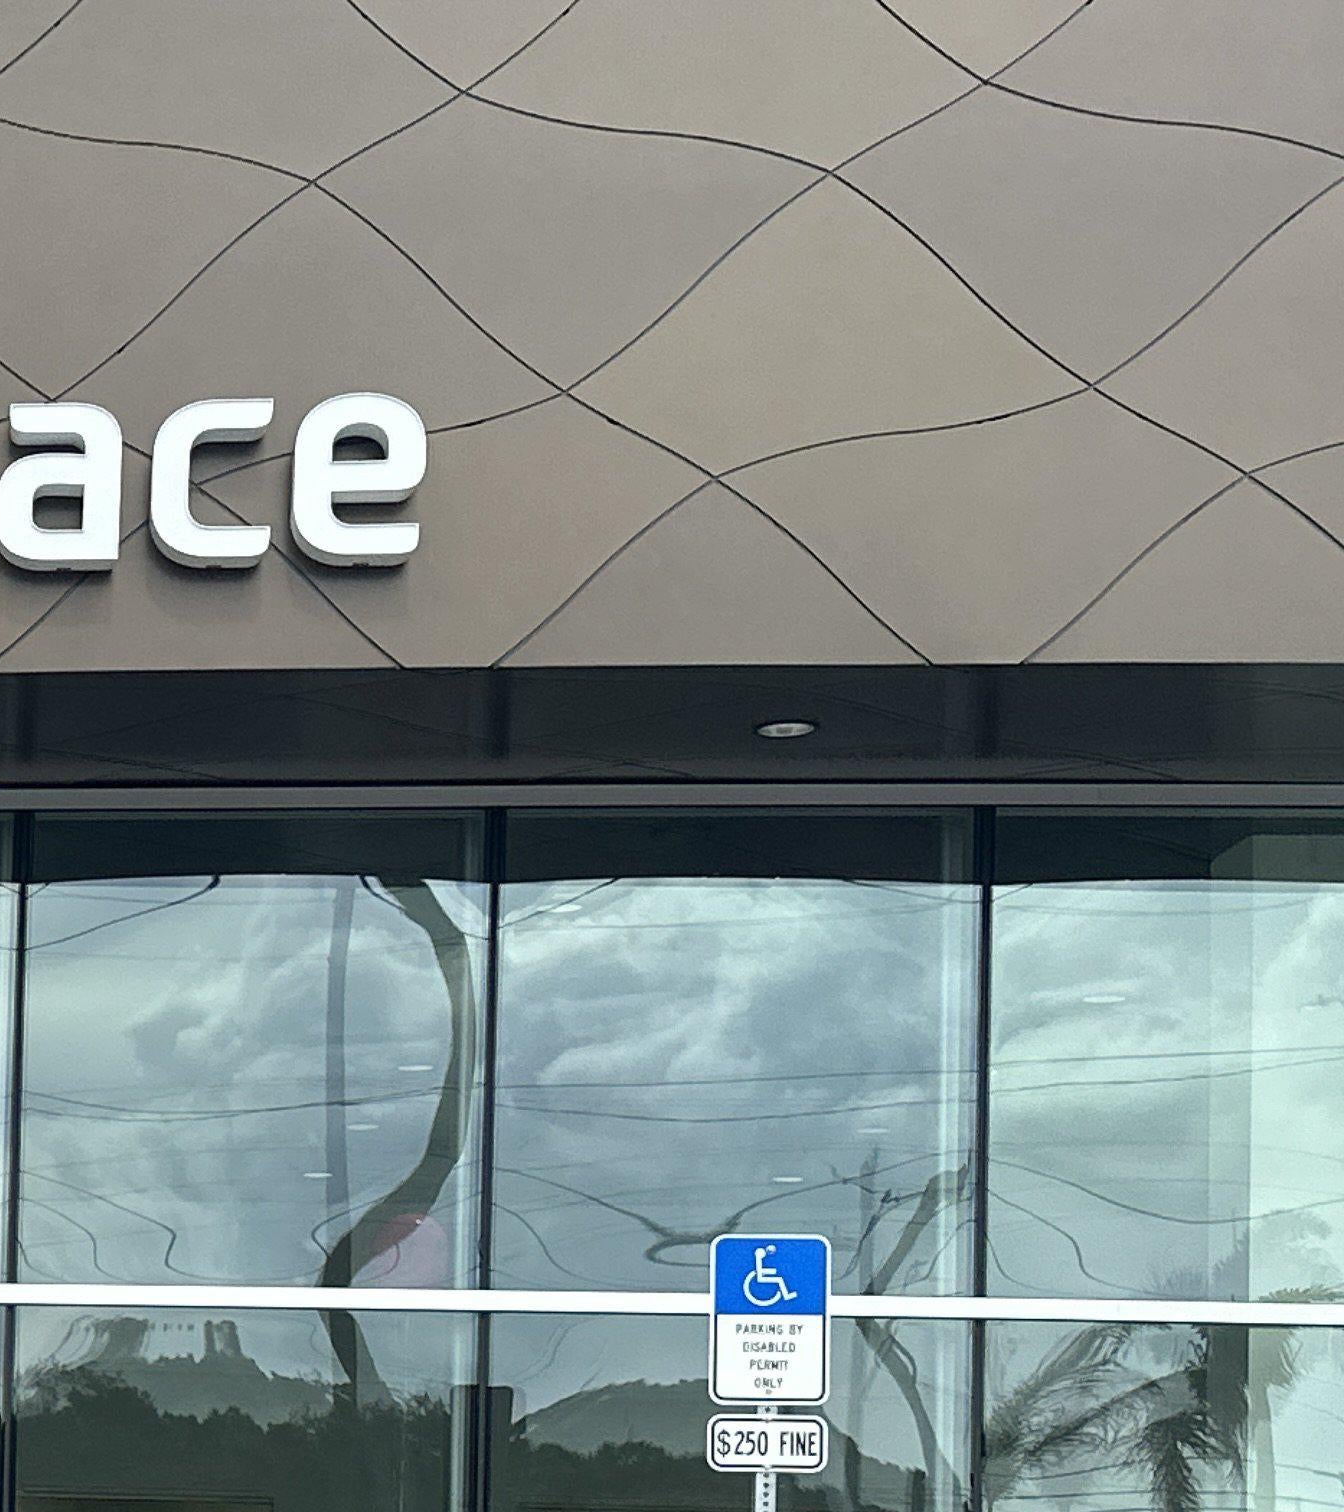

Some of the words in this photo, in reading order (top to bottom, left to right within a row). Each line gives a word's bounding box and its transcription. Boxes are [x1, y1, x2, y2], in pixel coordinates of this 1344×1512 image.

[735, 1324, 783, 1335] PARKING
[788, 1324, 803, 1335] BY
[743, 1342, 796, 1353] DISABLED
[750, 1359, 789, 1370] PERMIT
[754, 1377, 783, 1388] ONLY
[717, 1429, 769, 1458] $250
[780, 1431, 817, 1457] FINE
